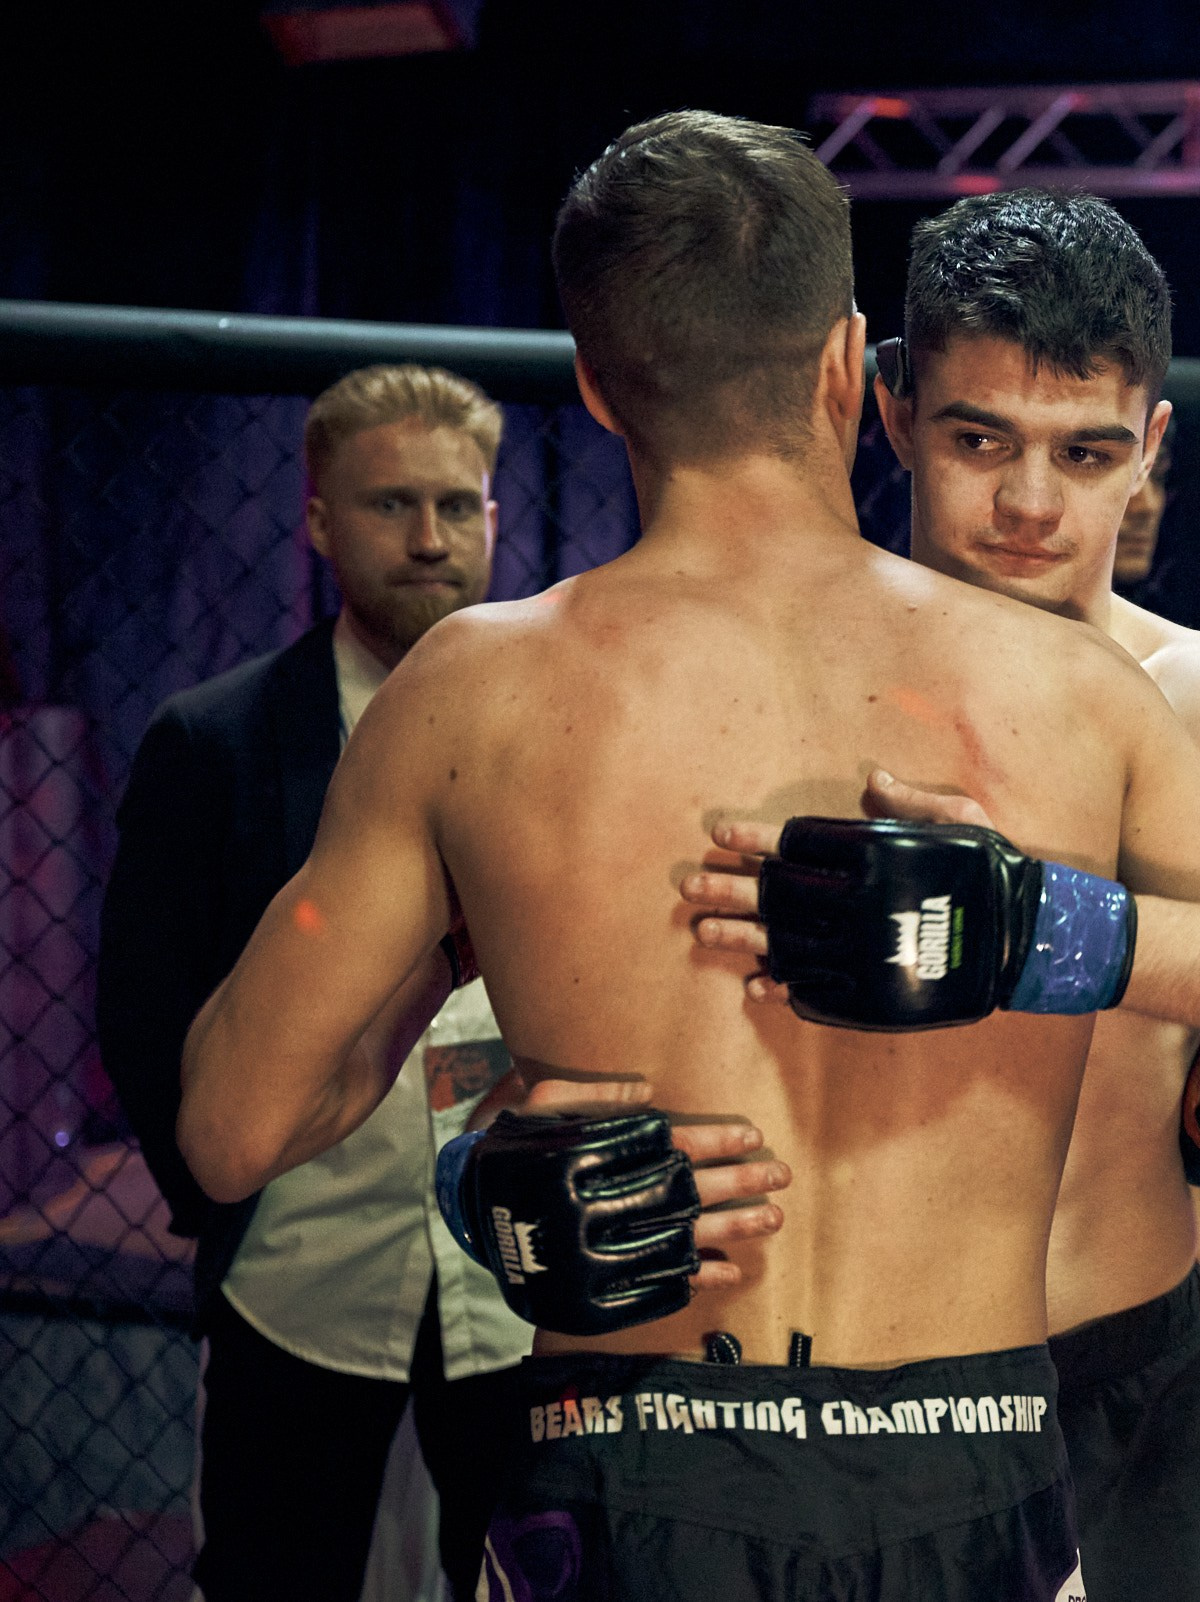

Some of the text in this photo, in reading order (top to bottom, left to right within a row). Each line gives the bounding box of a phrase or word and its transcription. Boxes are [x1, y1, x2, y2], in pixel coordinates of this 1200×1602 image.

[915, 894, 952, 981] GORILLA
[491, 1205, 526, 1285] GORILLA
[530, 1392, 1048, 1443] BEARS FIGHTING CHAMPIONSHIP
